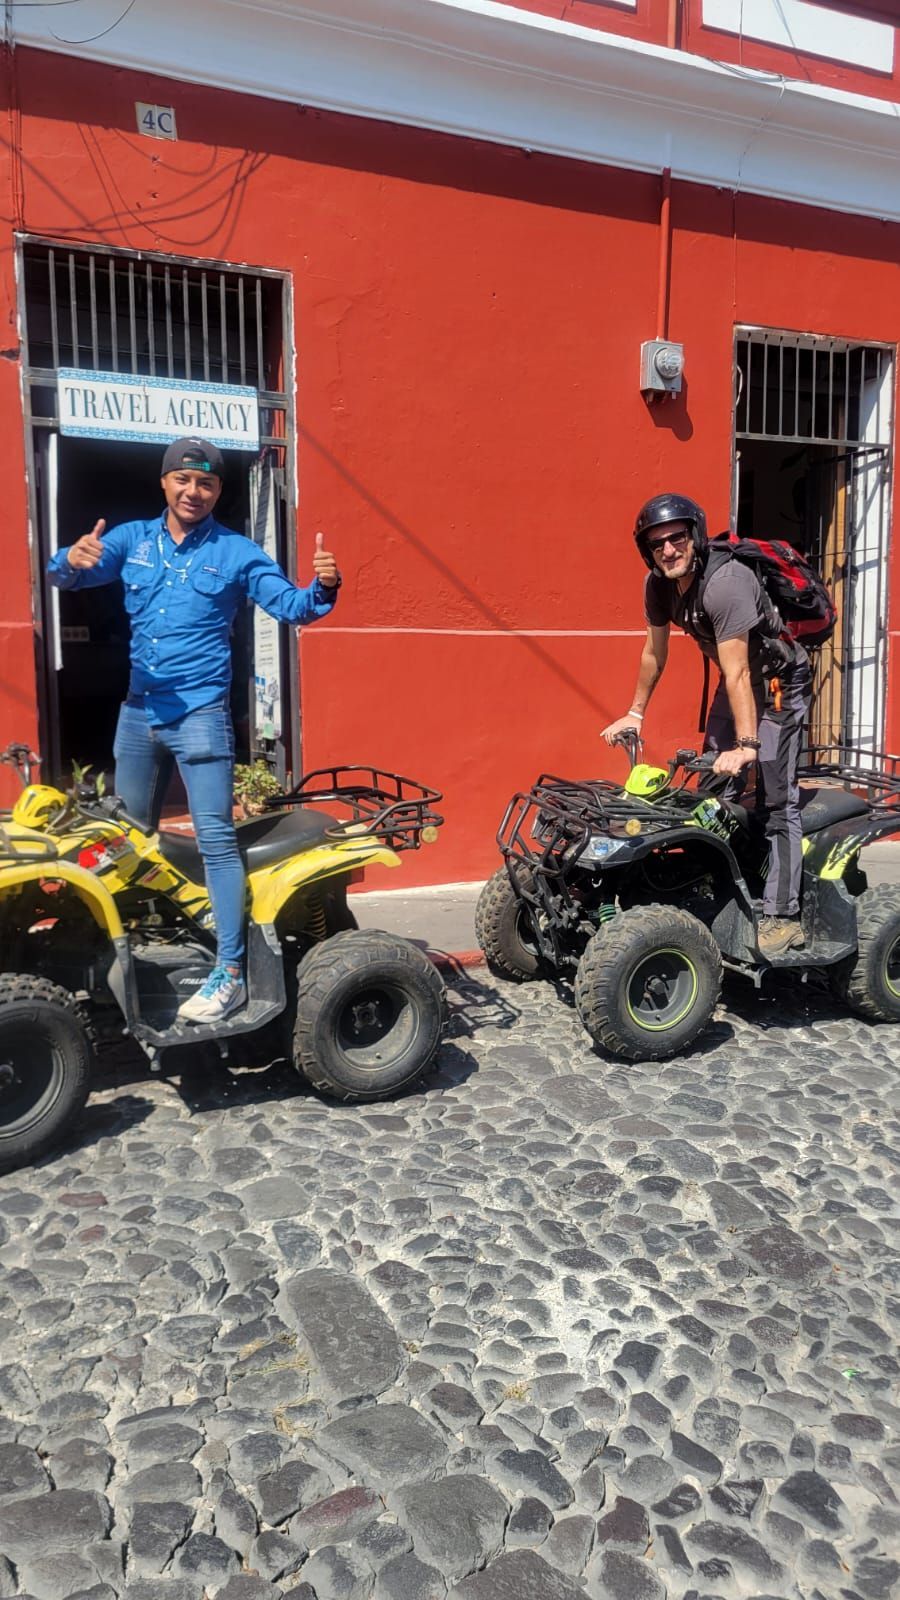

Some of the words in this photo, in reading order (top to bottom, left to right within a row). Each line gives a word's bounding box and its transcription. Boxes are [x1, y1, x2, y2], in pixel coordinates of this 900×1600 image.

[142, 110, 172, 134] 4C
[65, 387, 156, 424] TRAVEL
[164, 396, 252, 432] AGENCY
